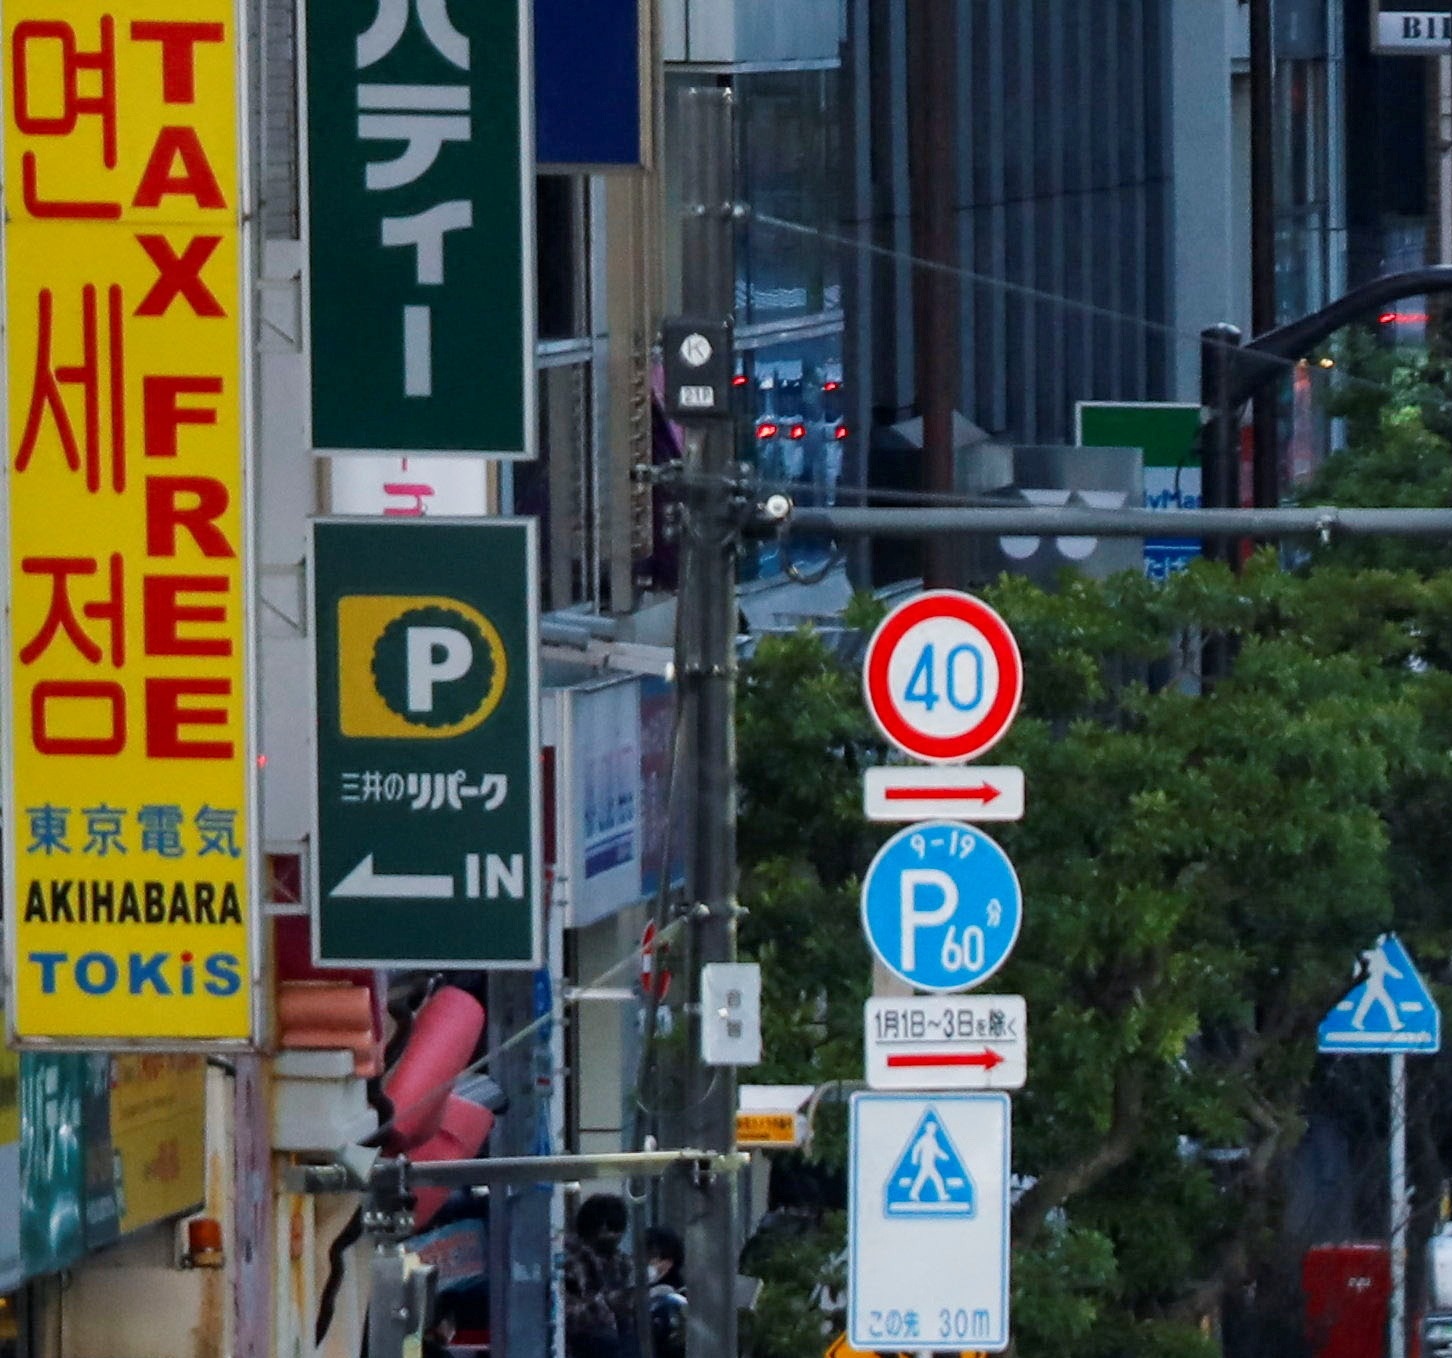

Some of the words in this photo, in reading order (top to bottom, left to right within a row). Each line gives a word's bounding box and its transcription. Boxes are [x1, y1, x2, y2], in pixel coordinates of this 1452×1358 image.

[131, 22, 226, 317] TAX
[143, 376, 236, 758] FREE
[407, 627, 473, 712] P
[904, 642, 983, 712] 40
[340, 769, 508, 810] 三井のリパーク
[26, 803, 241, 858] 東京電気
[910, 830, 976, 859] 9-19
[465, 853, 524, 898] IN
[24, 881, 241, 924] AKIHABARA
[901, 868, 959, 972] P
[941, 924, 985, 972] 60
[869, 1309, 920, 1337] この先
[938, 1307, 991, 1338] 30m
